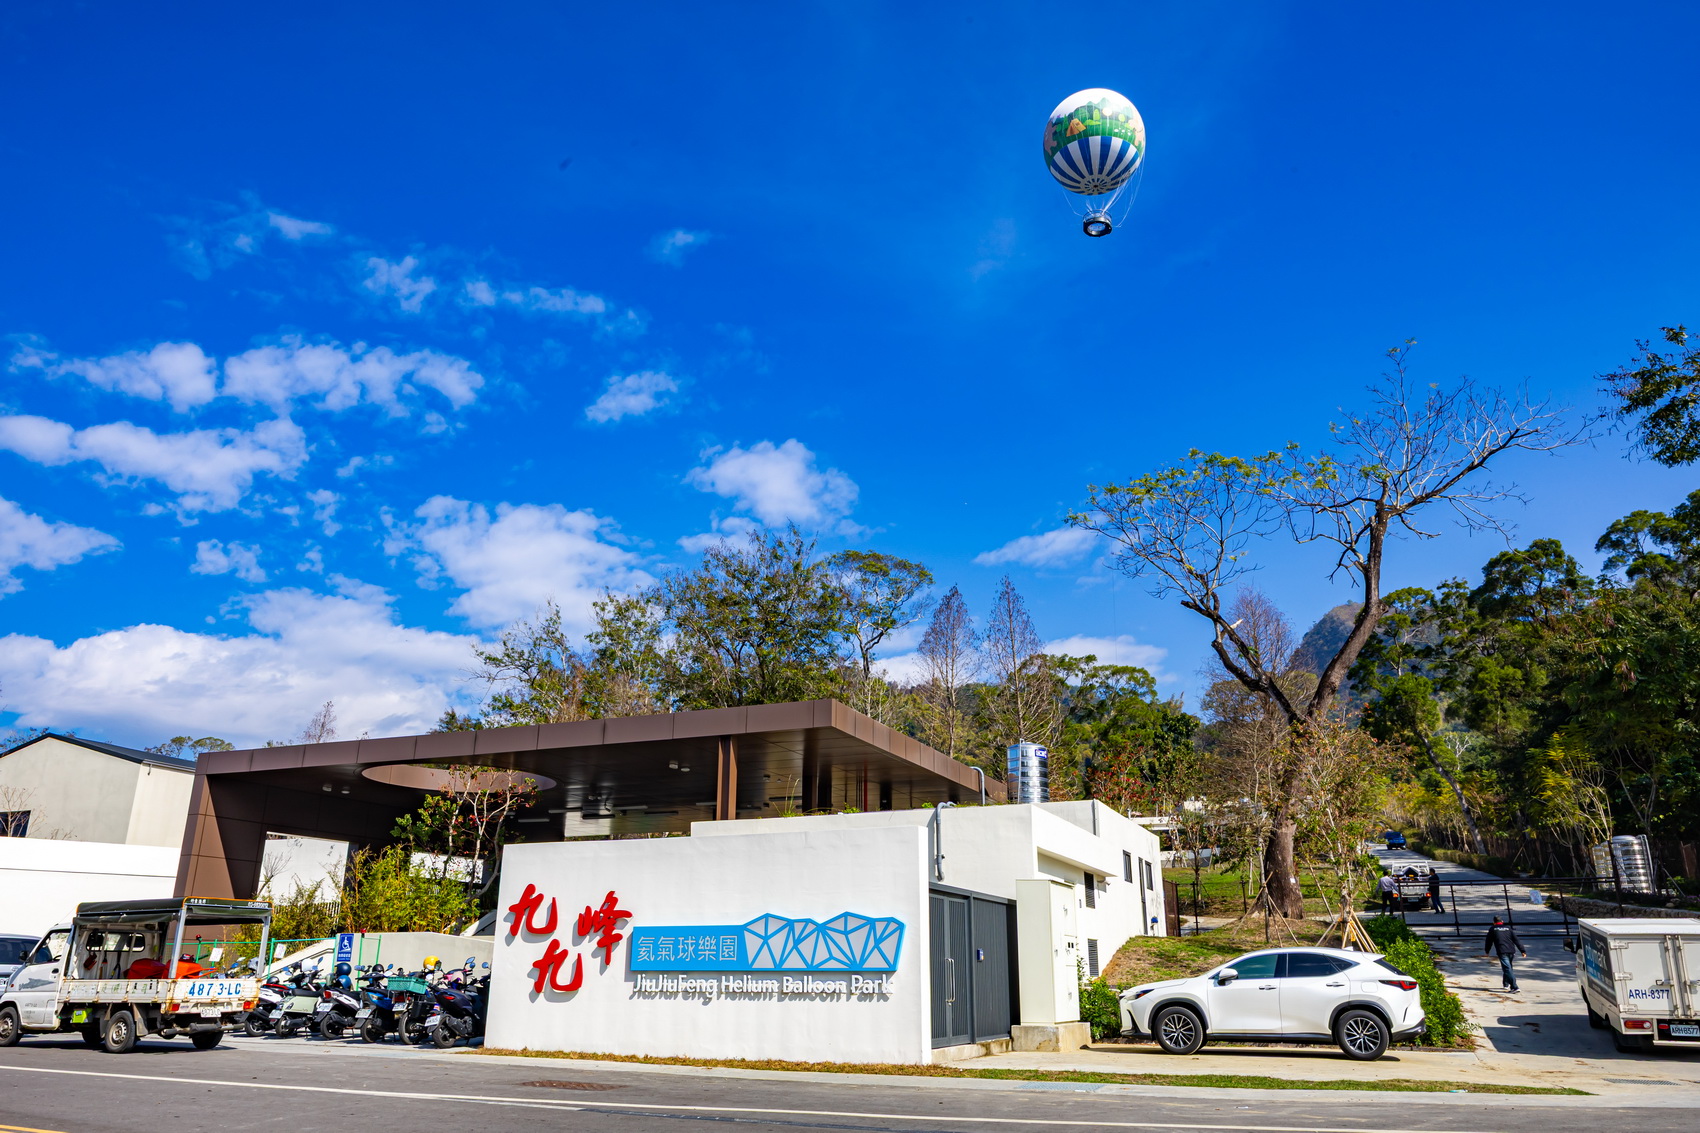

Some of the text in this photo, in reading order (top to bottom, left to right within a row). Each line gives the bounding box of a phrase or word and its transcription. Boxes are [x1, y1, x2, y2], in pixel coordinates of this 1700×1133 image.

[637, 935, 738, 962] 氦氣球樂園
[633, 973, 895, 998] JiuJiuFeng Helium Balloon Park
[1628, 988, 1670, 1000] ARH-8377
